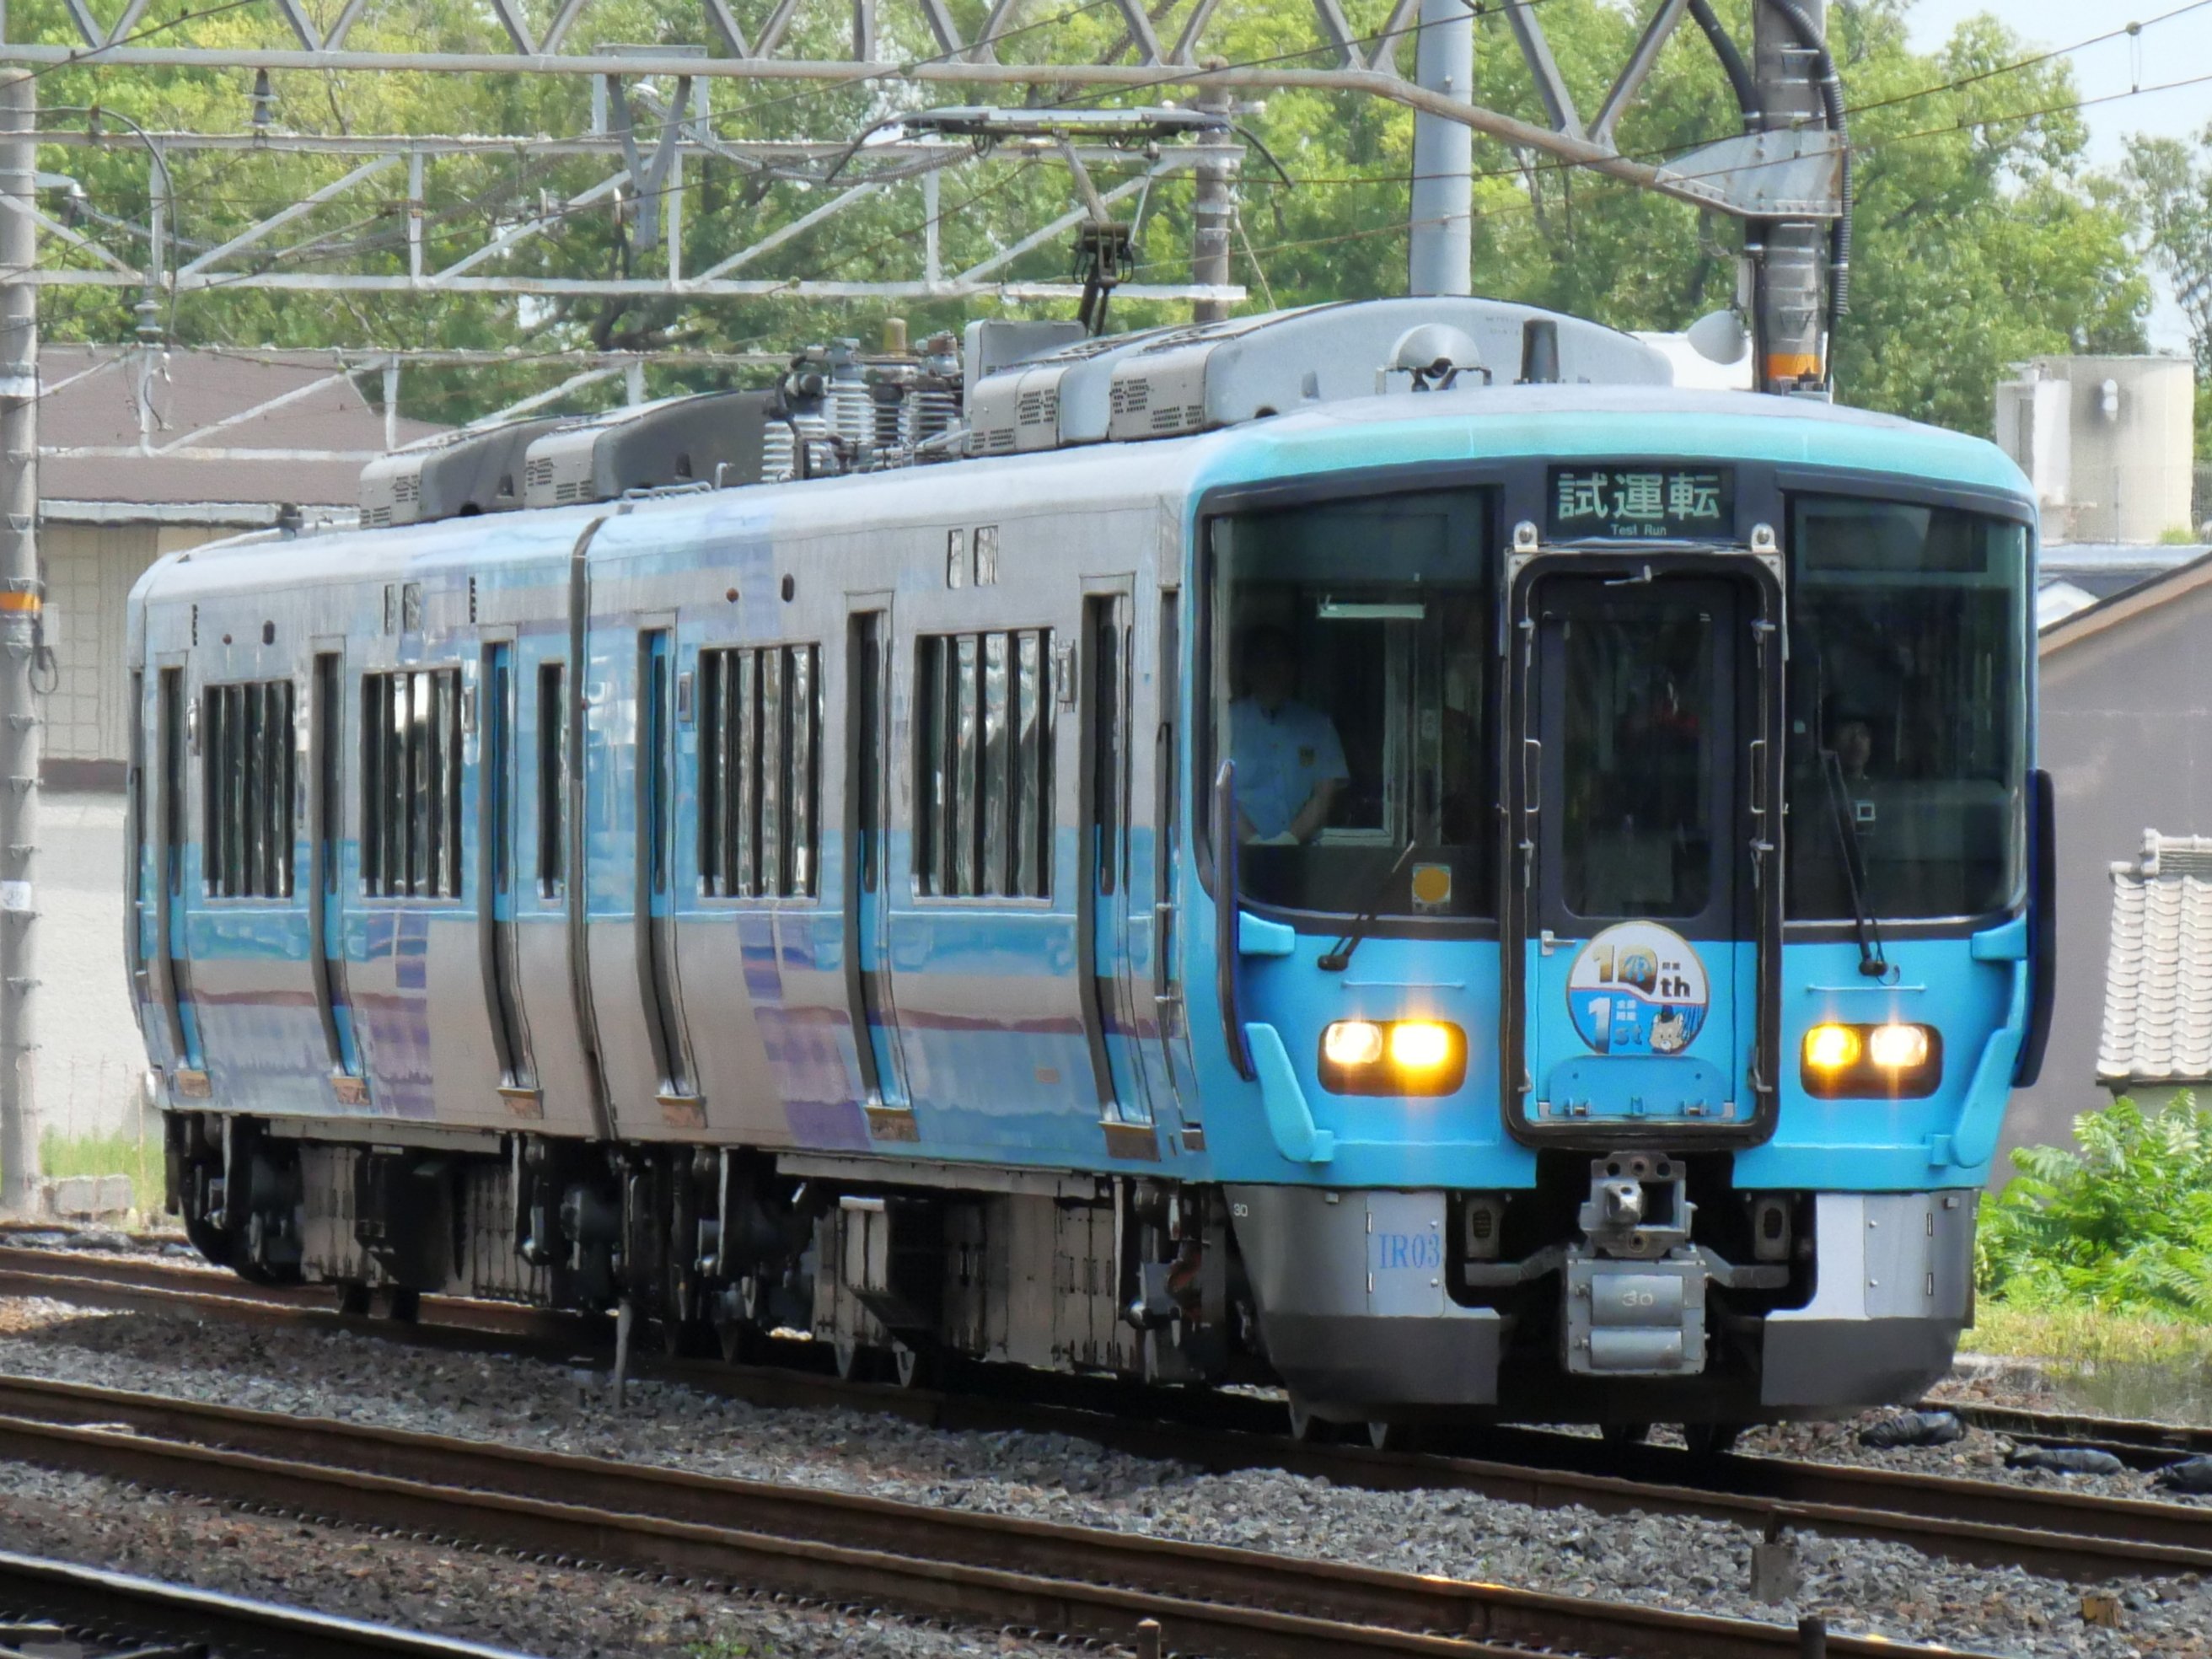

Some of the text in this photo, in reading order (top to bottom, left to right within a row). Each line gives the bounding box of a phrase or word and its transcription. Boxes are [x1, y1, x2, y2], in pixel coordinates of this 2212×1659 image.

[1558, 471, 1721, 521] 試運転
[1610, 523, 1667, 537] Test Run
[1377, 1233, 1441, 1270] IR03
[1621, 1290, 1654, 1307] 30
